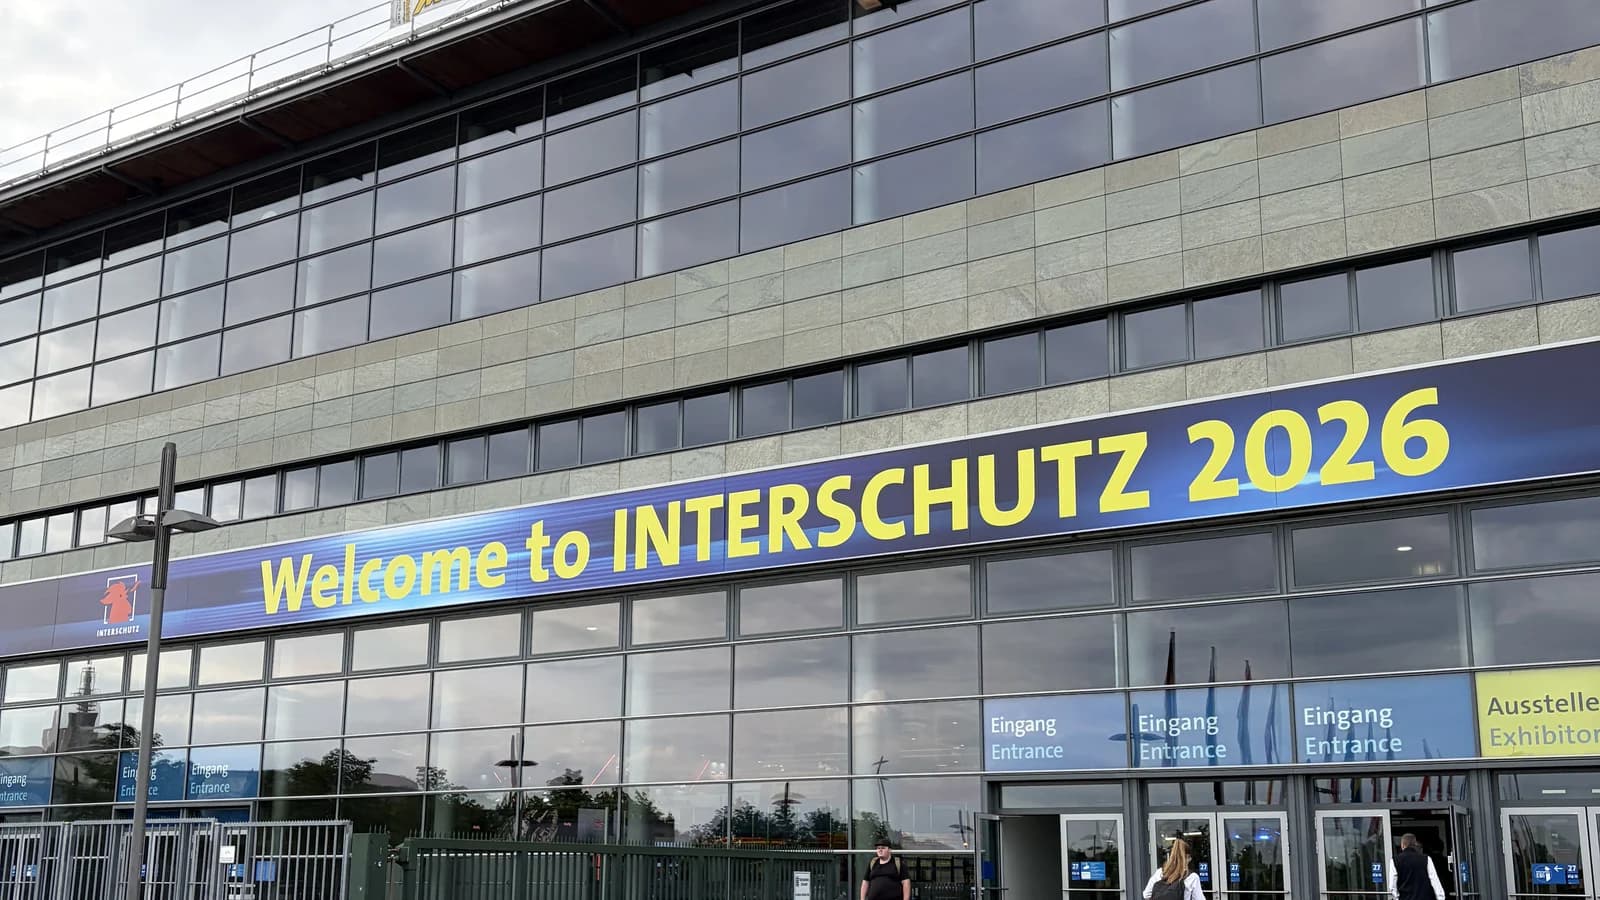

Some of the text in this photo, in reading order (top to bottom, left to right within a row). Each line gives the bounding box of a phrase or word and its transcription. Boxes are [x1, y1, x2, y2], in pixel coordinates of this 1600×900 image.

[261, 387, 1450, 614] Welcome to INTERSCHUTZ 2026
[97, 625, 140, 637] INTERSCHUTZ
[1488, 692, 1600, 716] Ausstelle
[991, 716, 1056, 737] Eingang
[1139, 714, 1219, 737] Eingang
[1304, 707, 1393, 730] Eingang
[991, 743, 1063, 760] Entrance
[1140, 742, 1227, 760] Entrance
[1305, 737, 1402, 756] Entrance
[122, 766, 157, 781] Eing
[192, 763, 229, 778] Eingang
[0, 772, 27, 788] ingang
[190, 782, 230, 794] Entrance
[0, 791, 27, 801] ntrance
[120, 785, 158, 797] Entce
